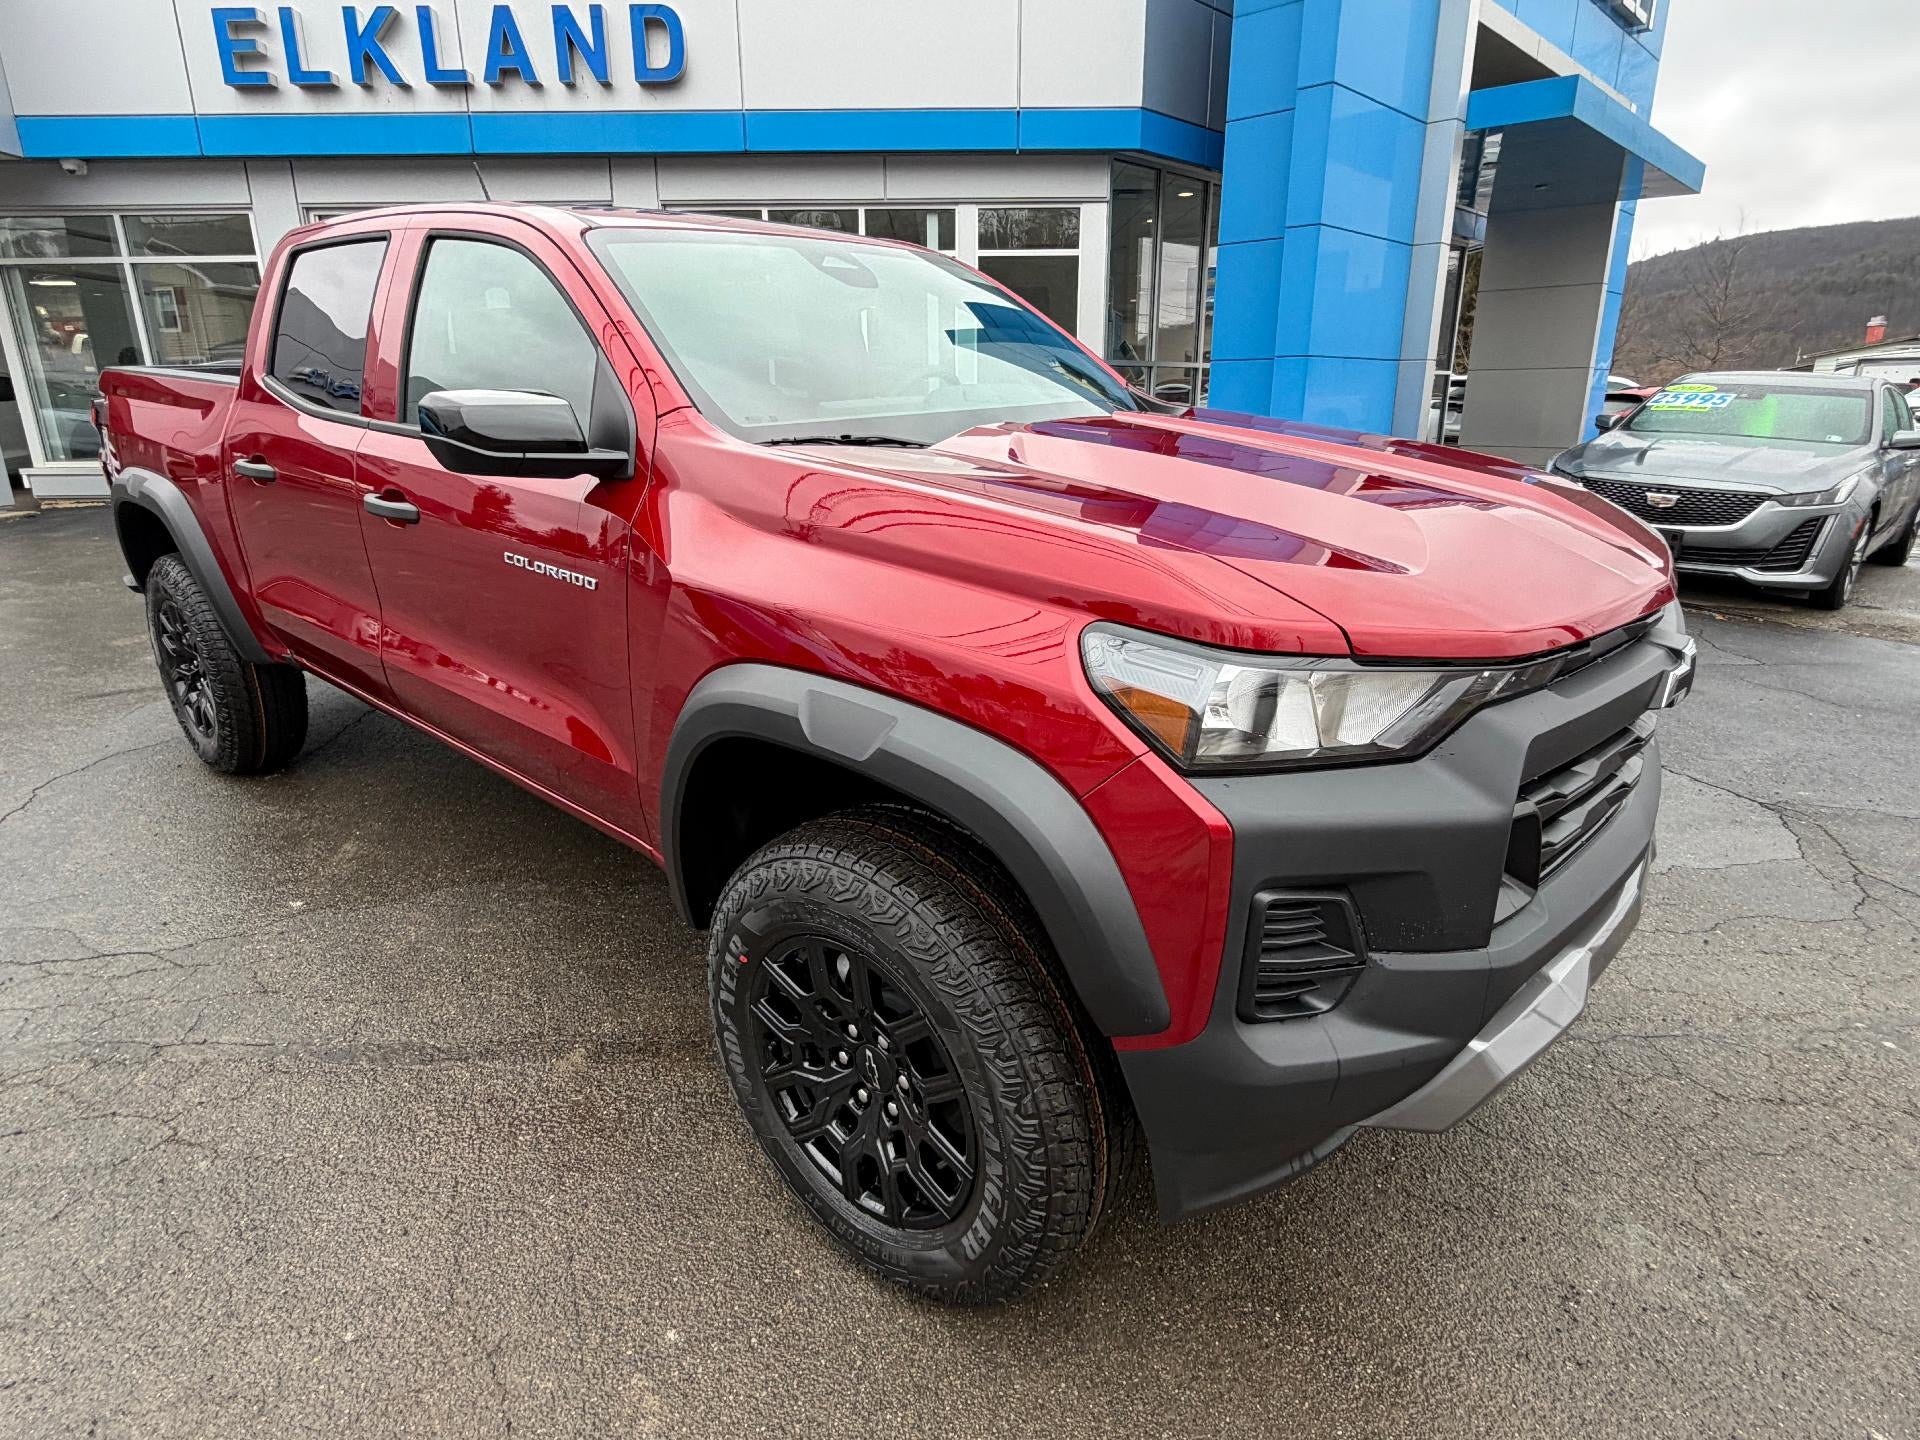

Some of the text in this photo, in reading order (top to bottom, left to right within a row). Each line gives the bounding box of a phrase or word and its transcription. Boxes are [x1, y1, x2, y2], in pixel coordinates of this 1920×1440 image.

[210, 3, 689, 88] ELKLAND
[1650, 393, 1732, 406] 25995
[503, 551, 598, 591] COLORADO
[718, 933, 760, 1110] OODYEAR
